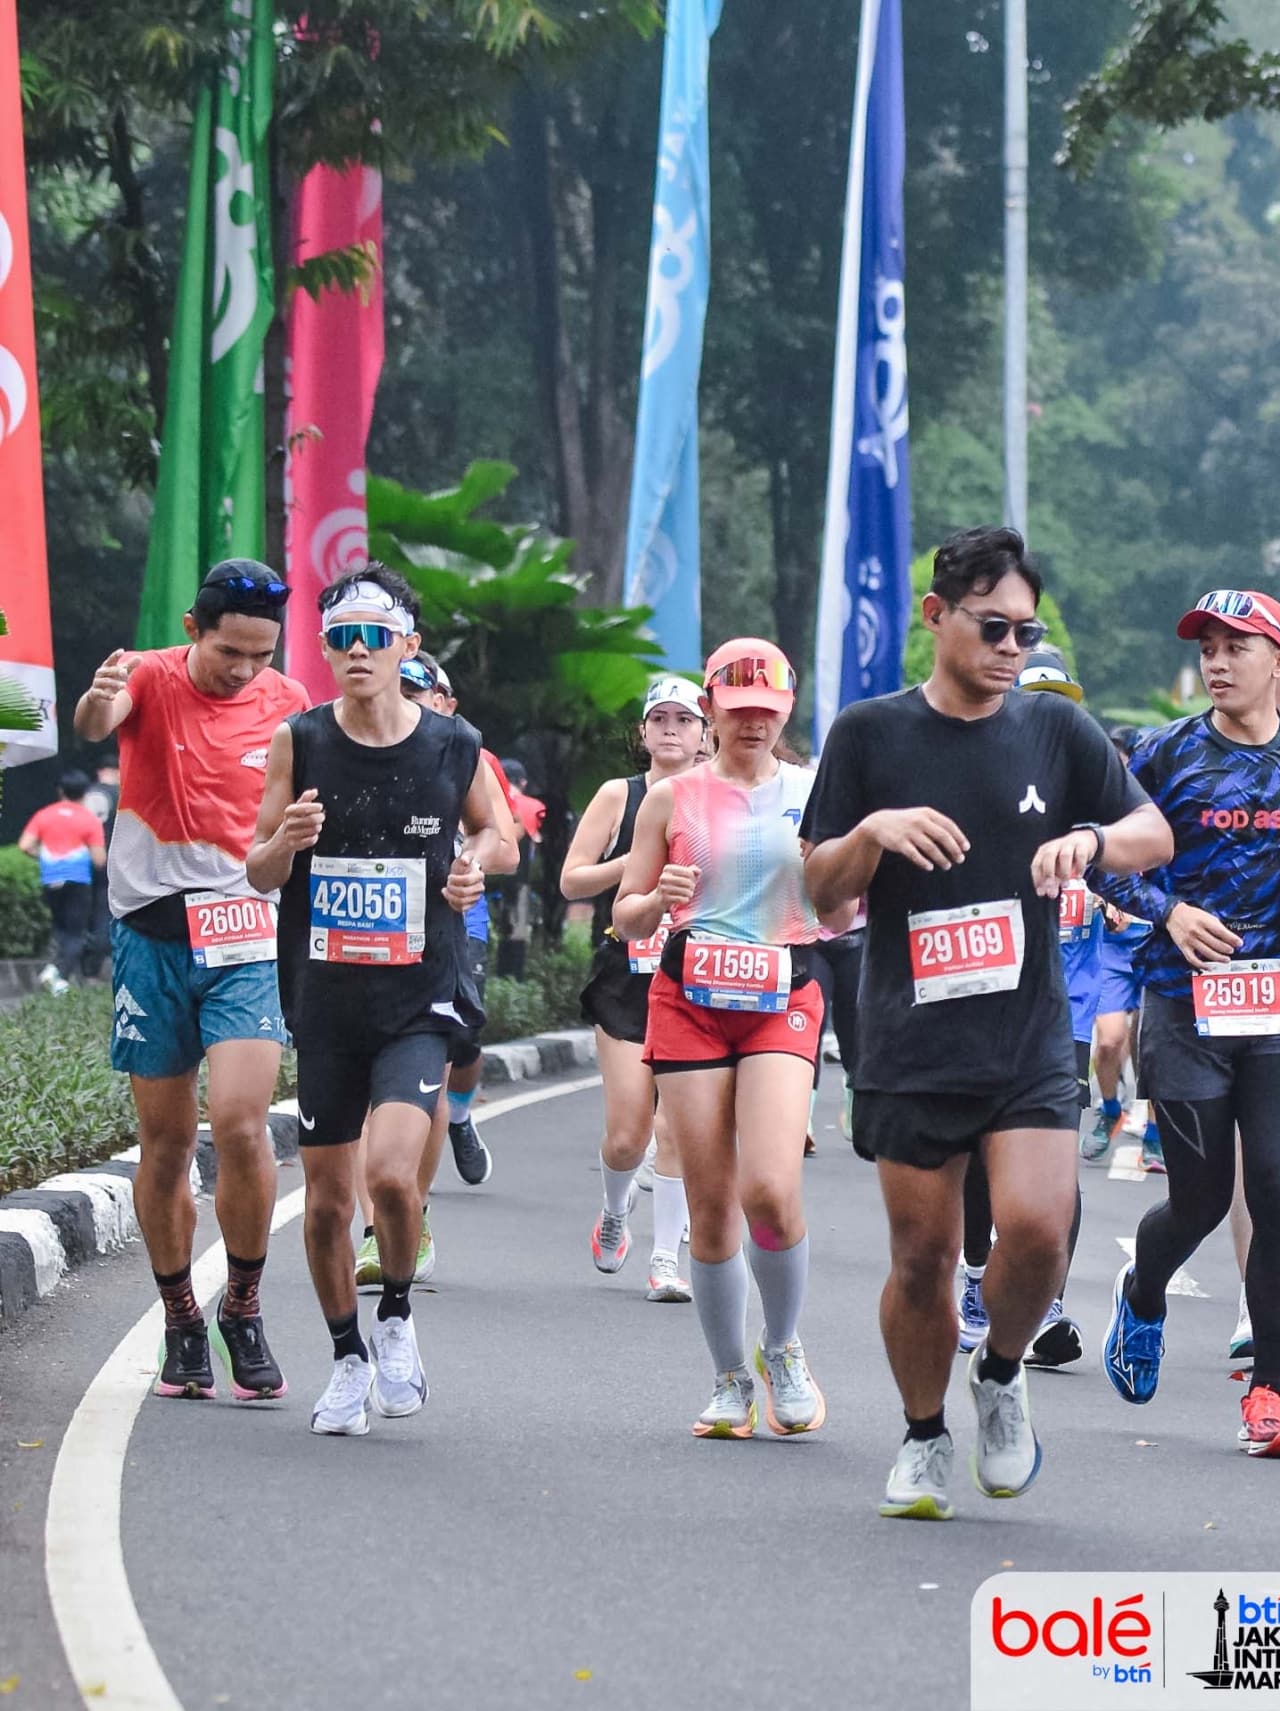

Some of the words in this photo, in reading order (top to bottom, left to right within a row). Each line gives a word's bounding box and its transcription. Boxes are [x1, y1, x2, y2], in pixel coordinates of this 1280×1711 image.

[313, 880, 402, 920] 42056
[1060, 893, 1077, 918] 31
[198, 901, 267, 937] 26001
[195, 955, 205, 964] B
[314, 938, 325, 952] C
[918, 921, 1004, 967] 29169
[693, 949, 768, 981] 21595
[1202, 976, 1276, 1007] 25919
